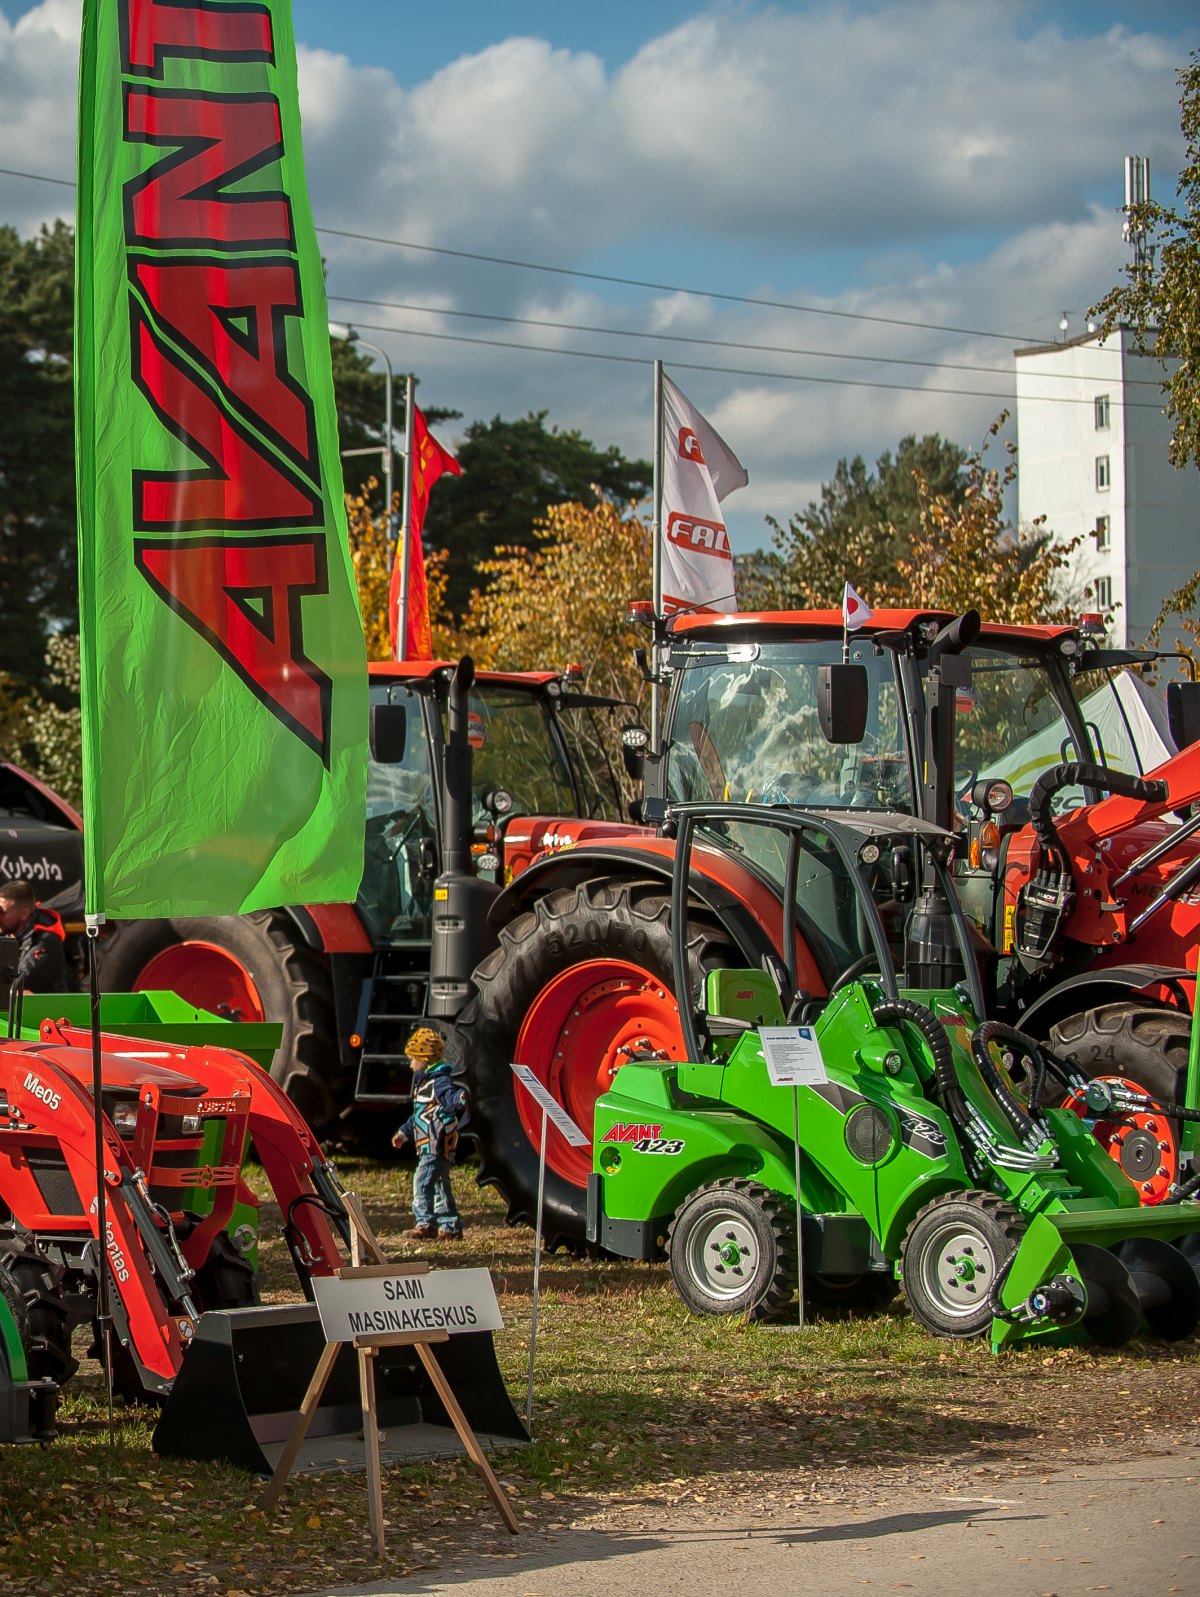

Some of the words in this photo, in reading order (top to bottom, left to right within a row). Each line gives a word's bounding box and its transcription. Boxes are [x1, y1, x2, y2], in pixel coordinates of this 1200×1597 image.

[118, 0, 330, 770] AVANT
[1089, 1044, 1117, 1063] 24
[22, 1071, 63, 1112] Me05
[599, 1121, 664, 1144] AVANT
[900, 1117, 949, 1145] 423
[631, 1137, 686, 1156] 423
[383, 1278, 425, 1301] SAMI
[347, 1304, 478, 1333] MASINAKESKUS
